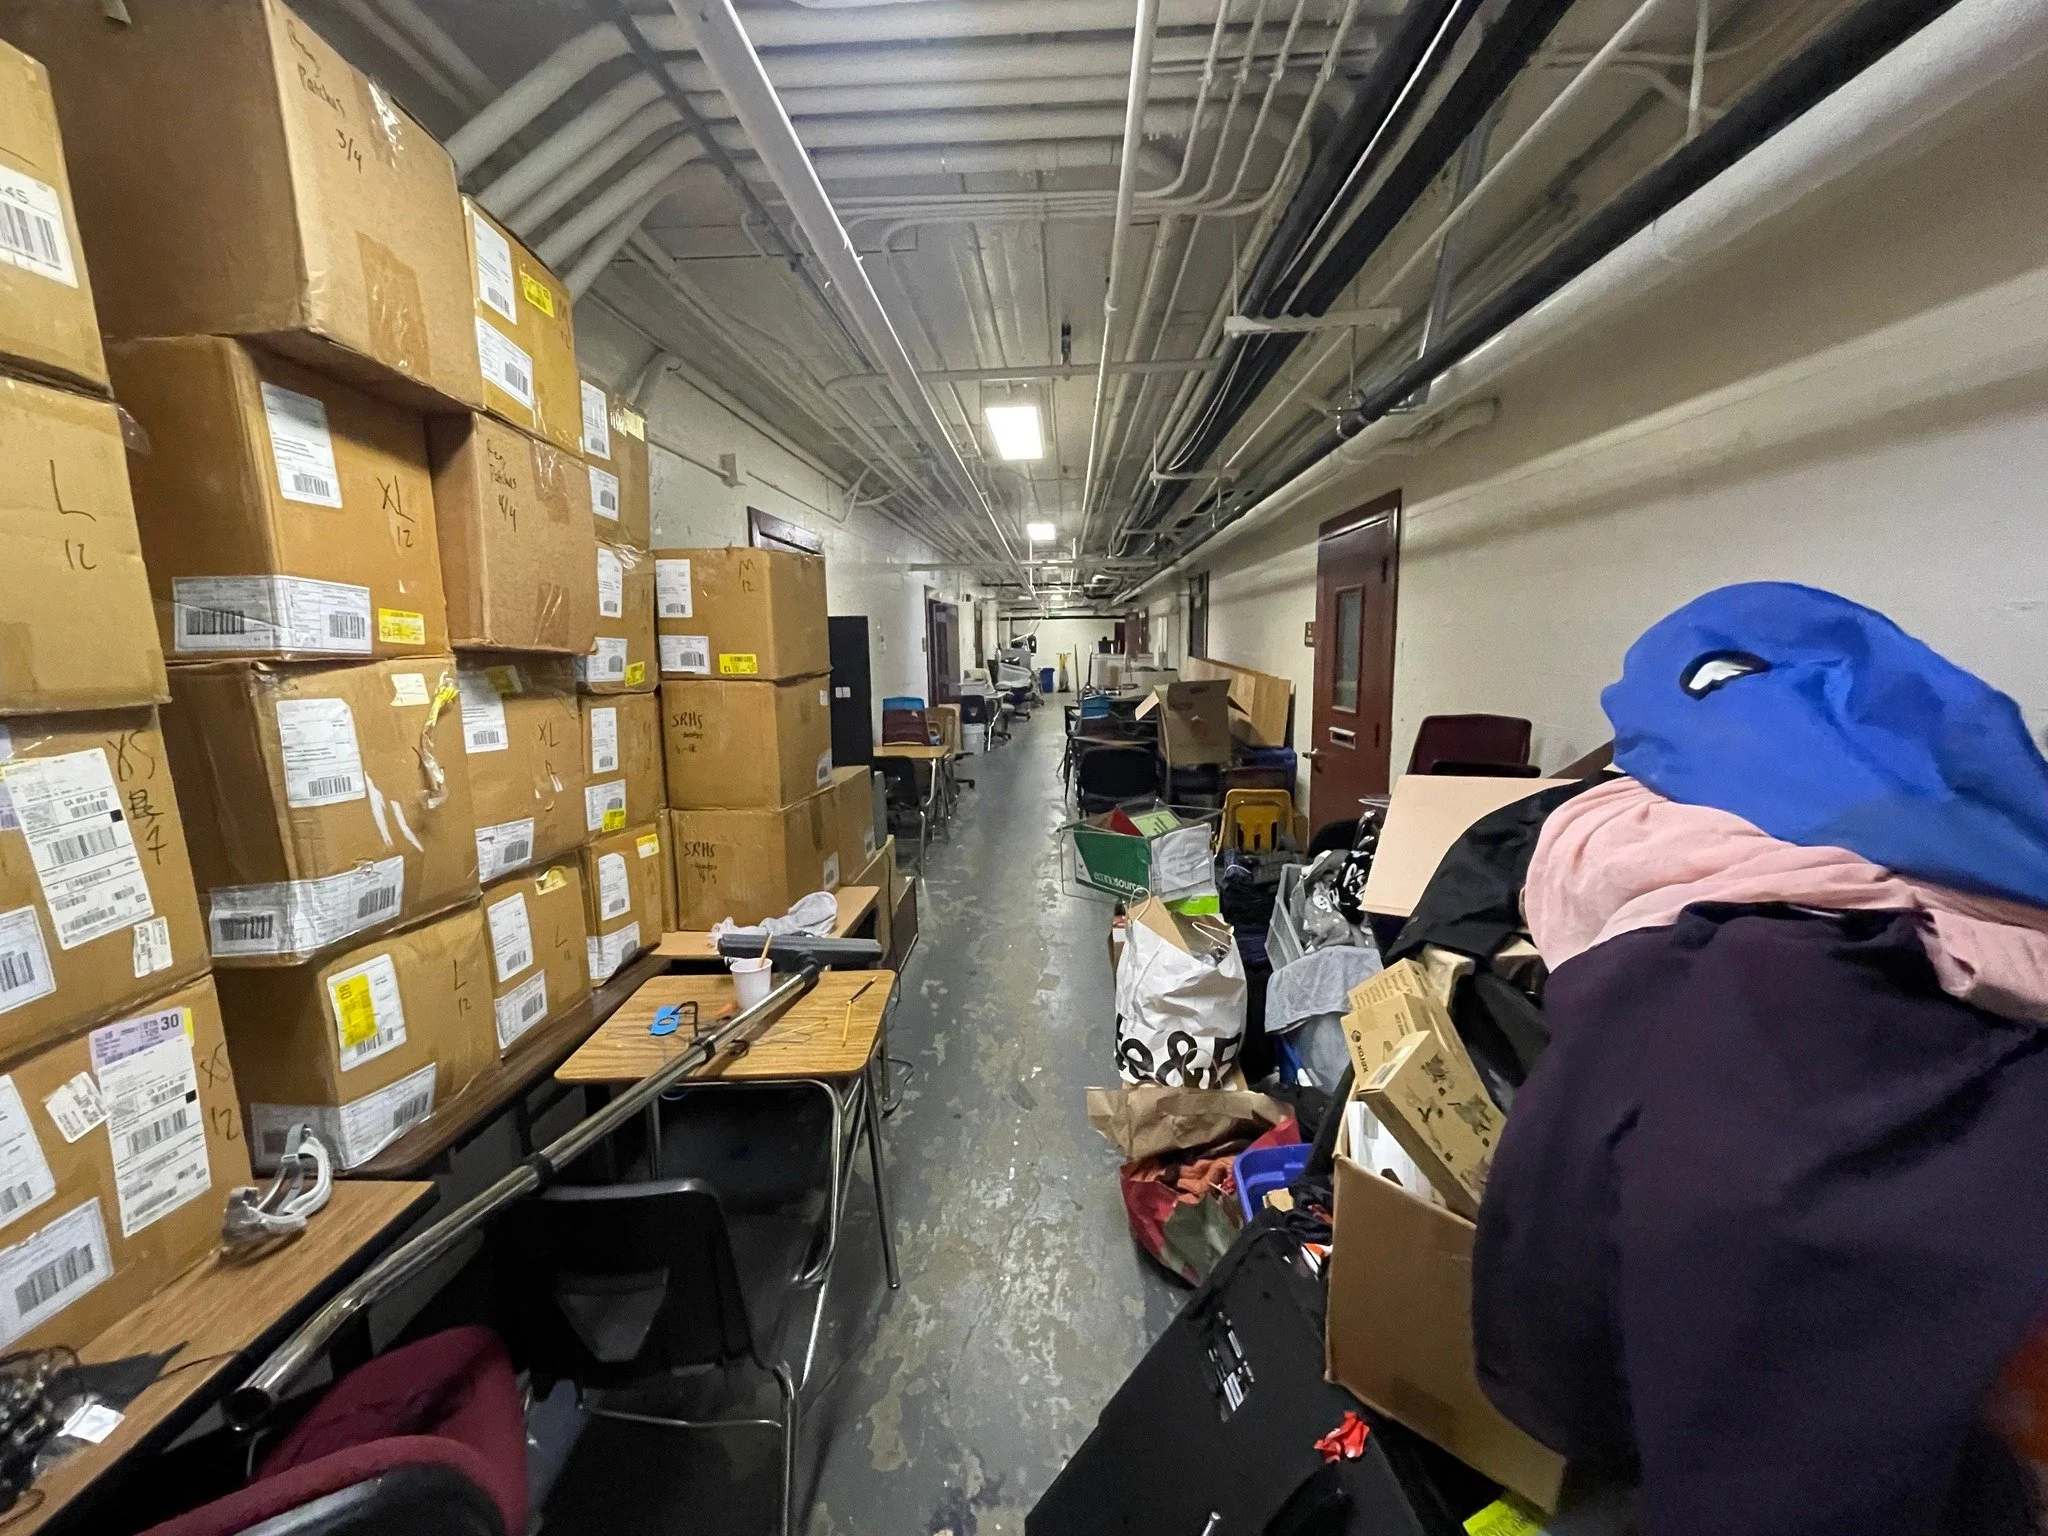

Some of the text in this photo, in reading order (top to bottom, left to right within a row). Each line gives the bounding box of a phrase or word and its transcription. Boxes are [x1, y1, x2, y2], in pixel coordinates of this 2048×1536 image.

[335, 128, 362, 174] 3/4
[49, 458, 97, 522] L
[376, 474, 416, 523] XL
[396, 525, 413, 548] 12
[64, 538, 97, 571] 12
[741, 579, 756, 595] 12
[537, 719, 561, 748] XL
[671, 710, 704, 729] SRHS
[683, 840, 717, 859] SRHS
[555, 925, 568, 948] L
[453, 959, 468, 991] L
[458, 997, 472, 1017] 12
[159, 1012, 180, 1032] 30
[1354, 1042, 1370, 1074] xerox
[210, 1106, 240, 1141] 12
